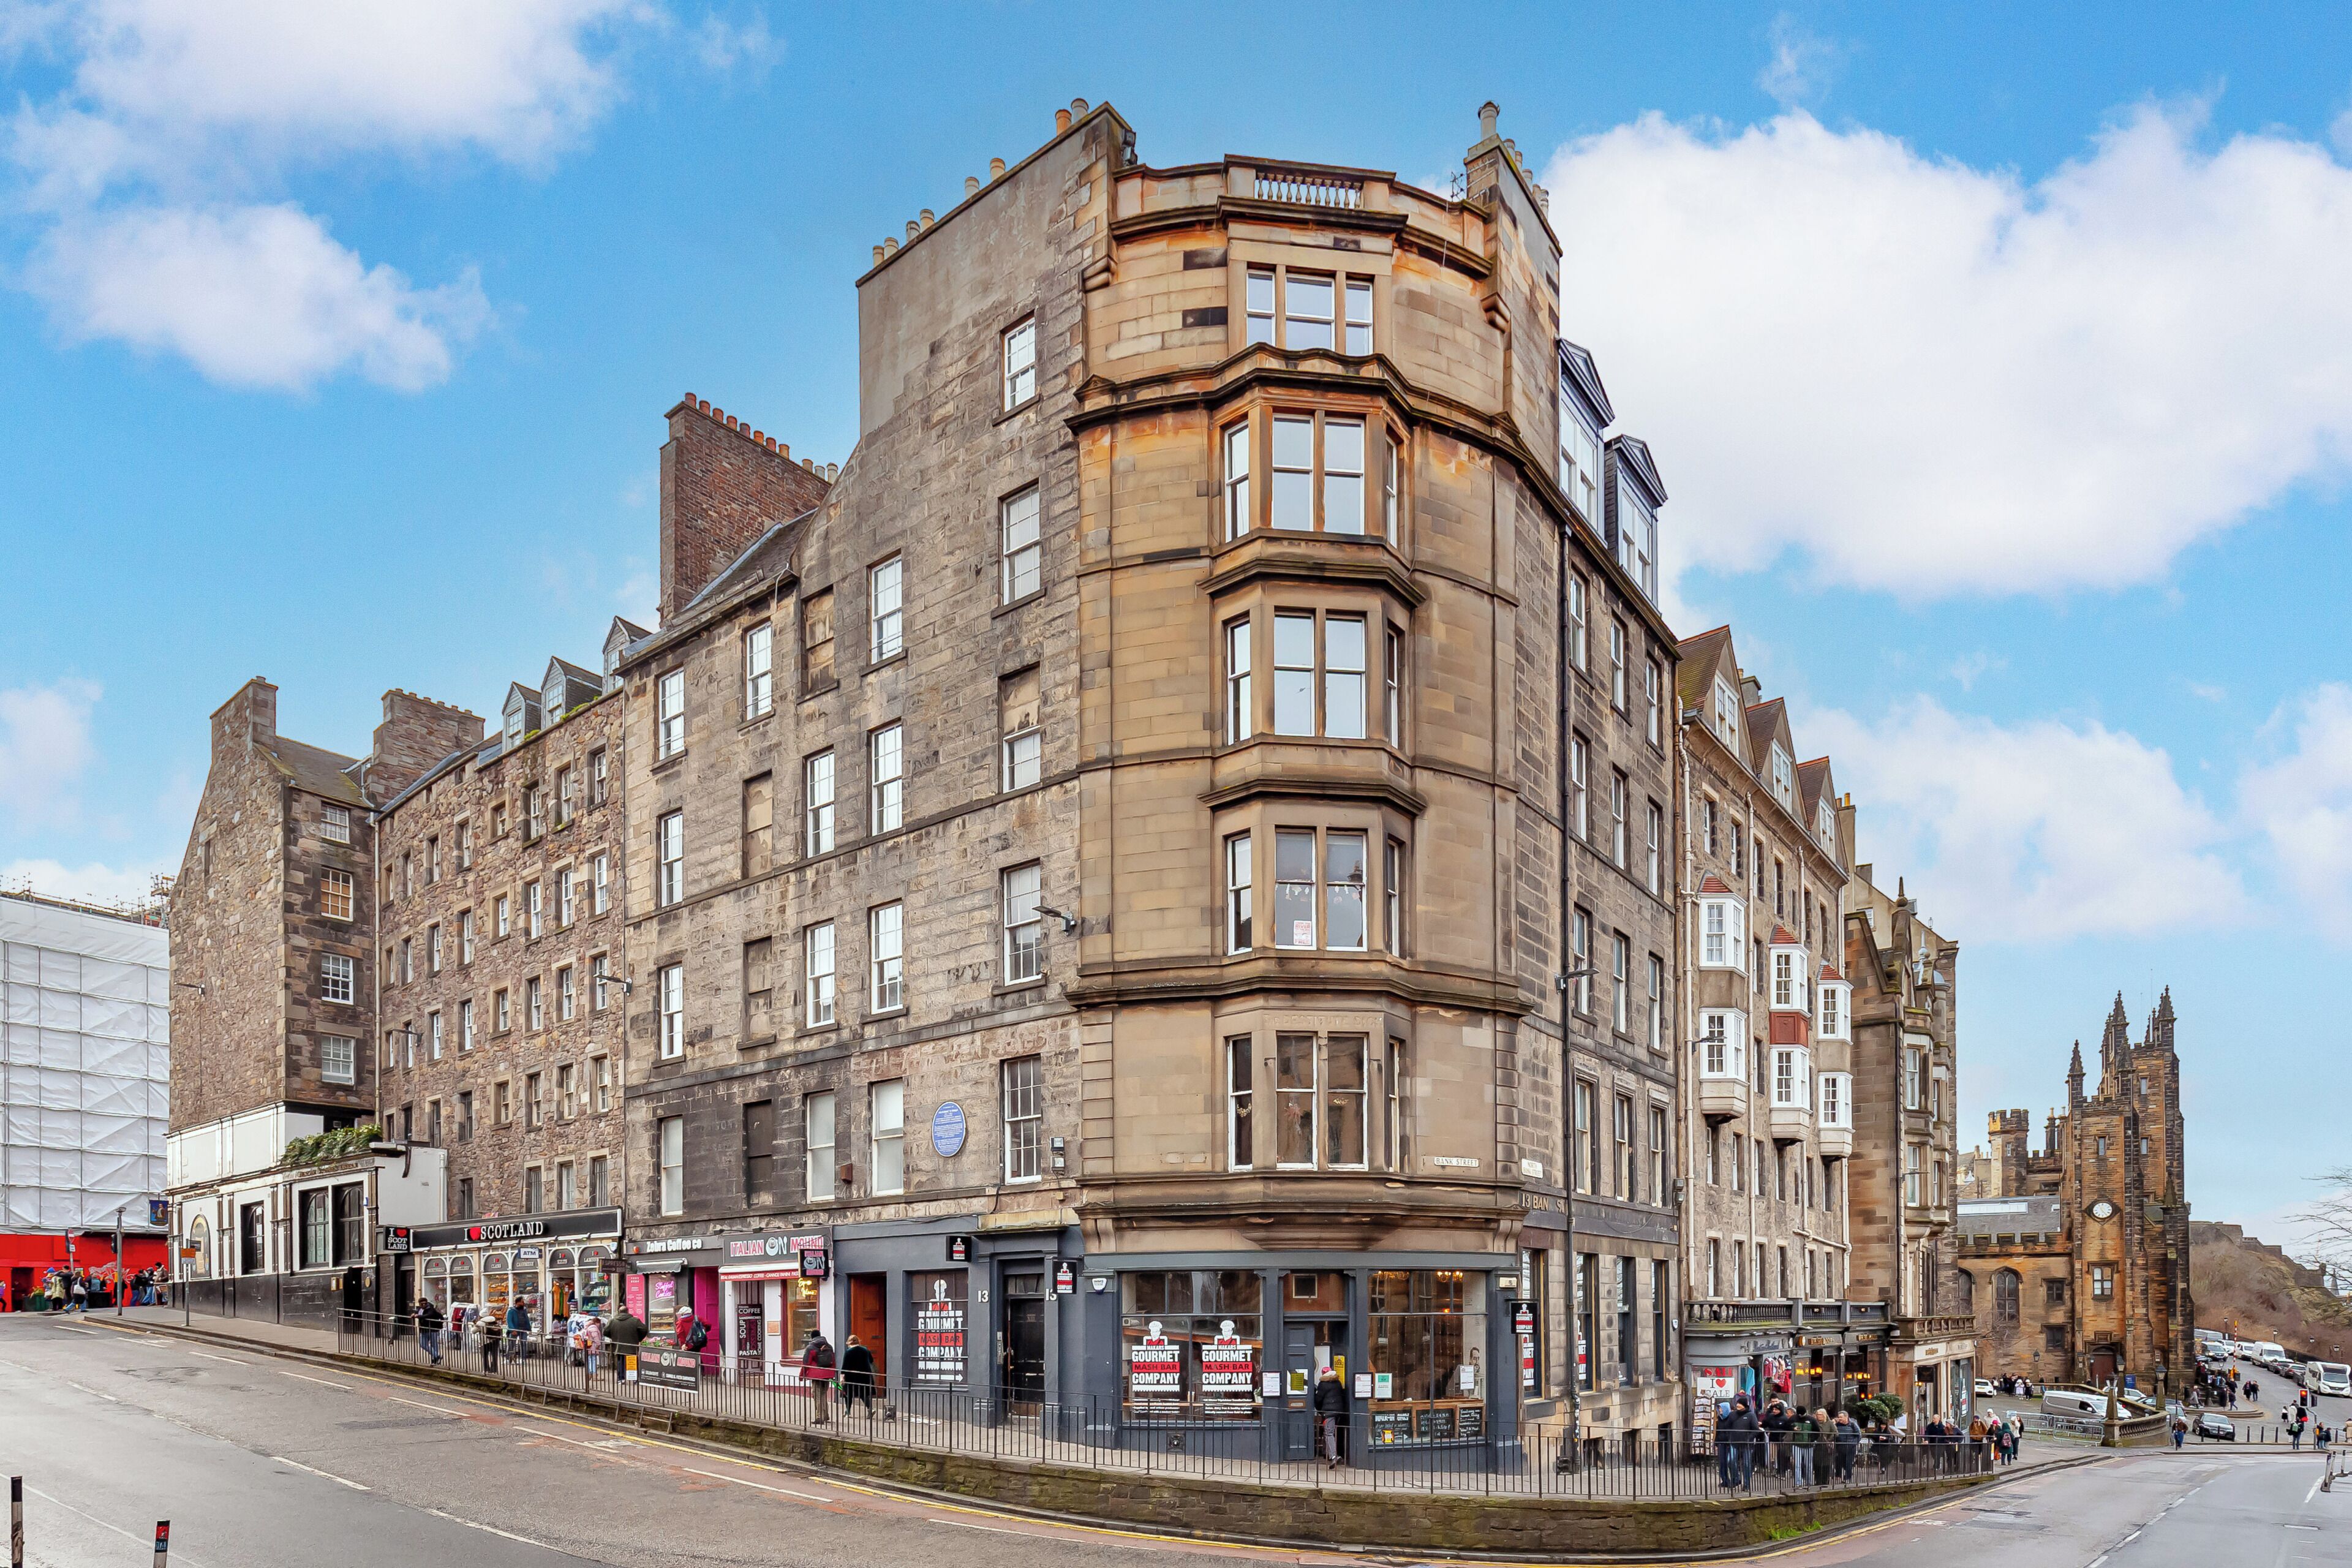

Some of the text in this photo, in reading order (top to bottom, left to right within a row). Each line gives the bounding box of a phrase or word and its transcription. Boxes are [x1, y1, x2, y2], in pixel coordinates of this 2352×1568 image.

[1522, 1193, 1530, 1208] 13
[389, 1227, 394, 1237] I
[464, 1221, 543, 1241] I SCOTLAND
[667, 1238, 692, 1251] Coffee
[730, 1235, 824, 1257] ITALIAN ON MOUND
[804, 1256, 825, 1269] ON
[655, 1281, 674, 1291] Stuffed
[655, 1290, 672, 1298] Cookies
[978, 1290, 989, 1302] 13
[918, 1317, 963, 1332] GOURMET
[661, 1351, 677, 1366] ON
[918, 1346, 963, 1360] COMPANY
[1132, 1351, 1180, 1362] GOURMET
[1202, 1350, 1253, 1362] GOURMET
[1132, 1373, 1180, 1384] COMPANY
[1202, 1373, 1252, 1384] COMPANY
[1710, 1378, 1715, 1389] I
